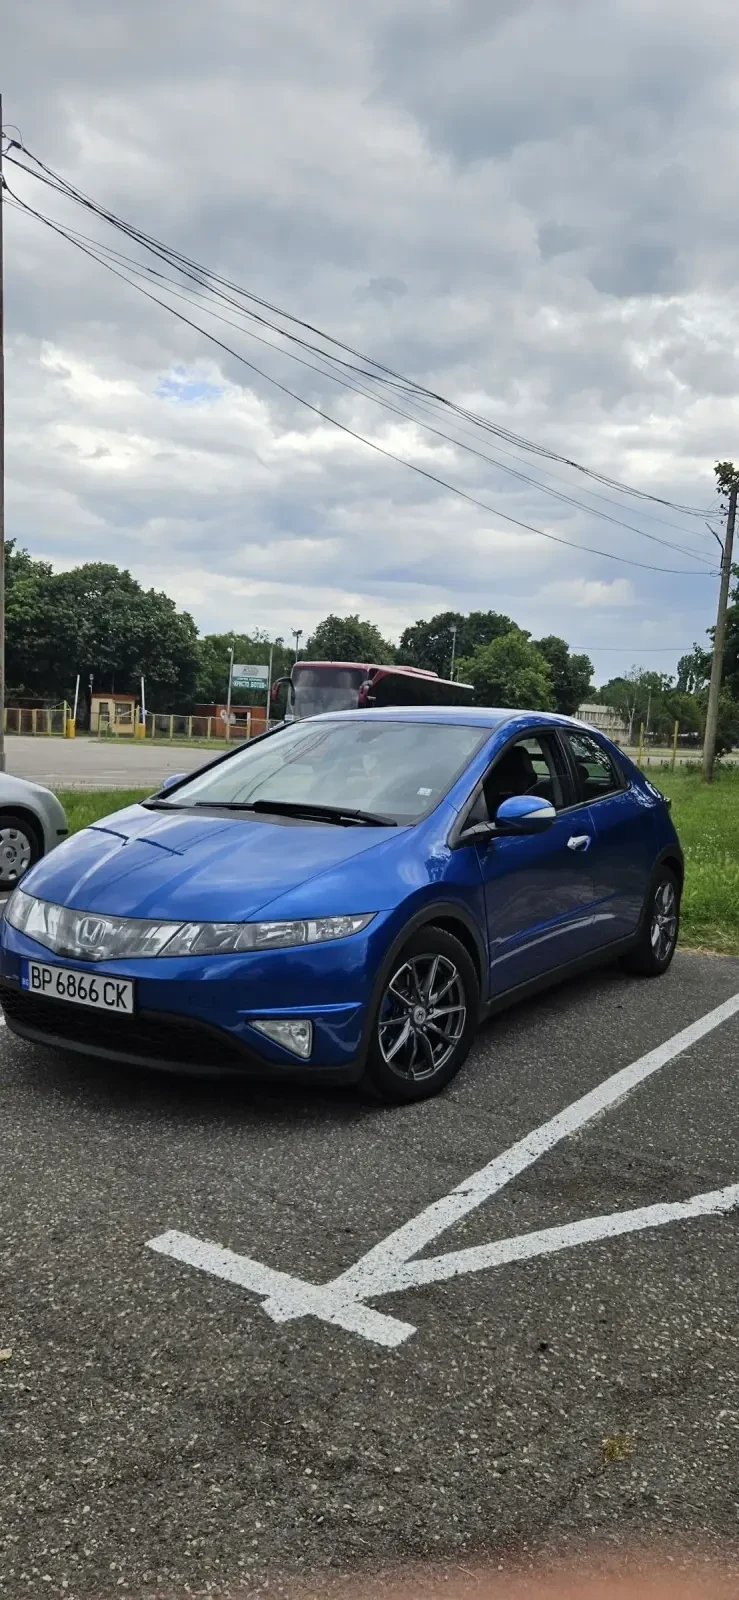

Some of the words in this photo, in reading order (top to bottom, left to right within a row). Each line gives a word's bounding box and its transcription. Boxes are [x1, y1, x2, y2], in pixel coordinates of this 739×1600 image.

[31, 965, 52, 990] BP
[56, 972, 98, 1002] 6866
[103, 981, 127, 1009] CK
